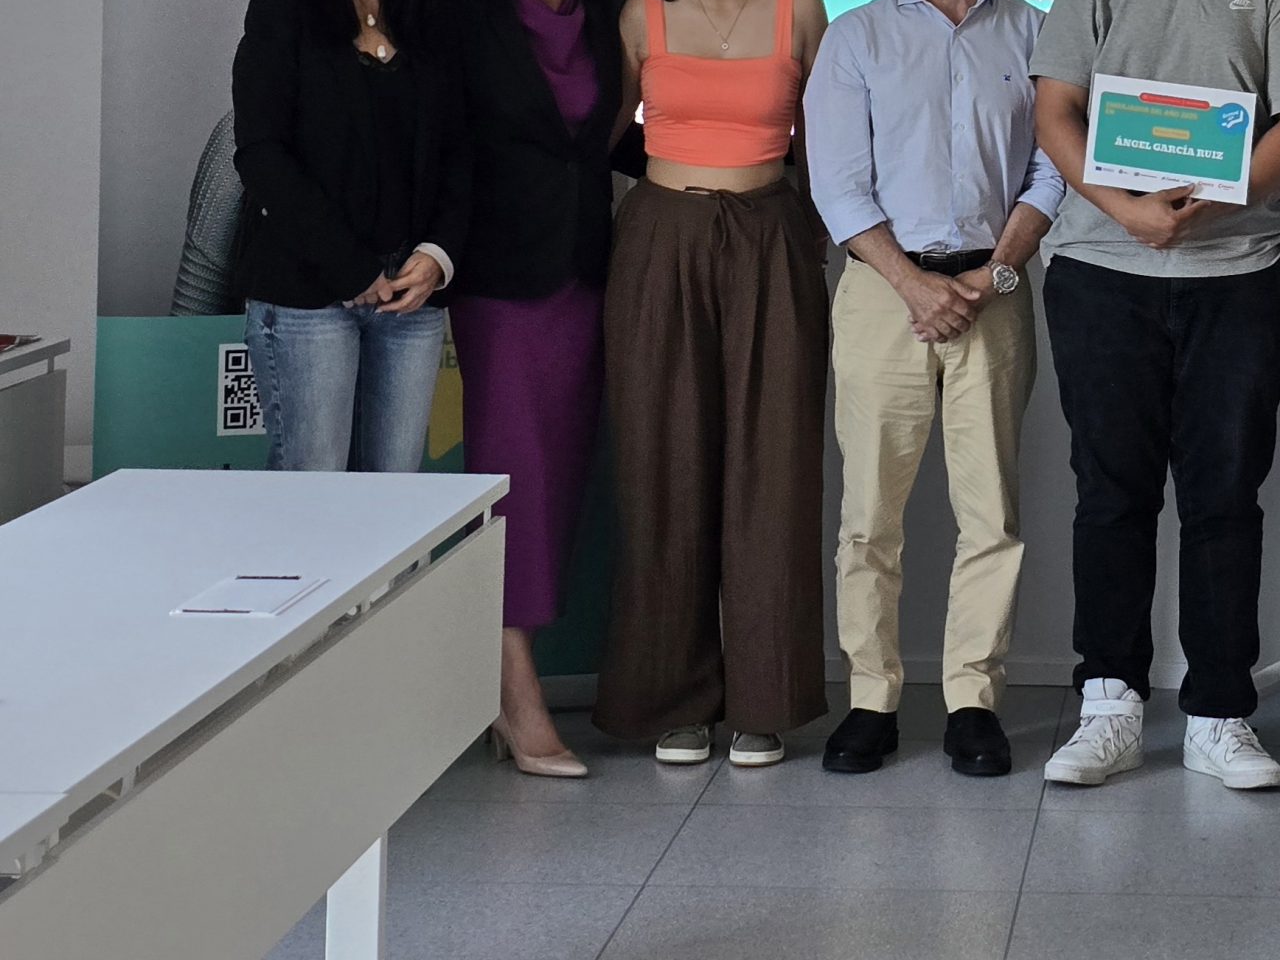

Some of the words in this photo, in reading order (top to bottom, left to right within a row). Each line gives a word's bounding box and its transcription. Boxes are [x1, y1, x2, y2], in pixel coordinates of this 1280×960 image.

[1114, 136, 1152, 150] ÁNGEL
[1152, 142, 1195, 157] GARCÍA
[1195, 149, 1225, 161] RUIZ
